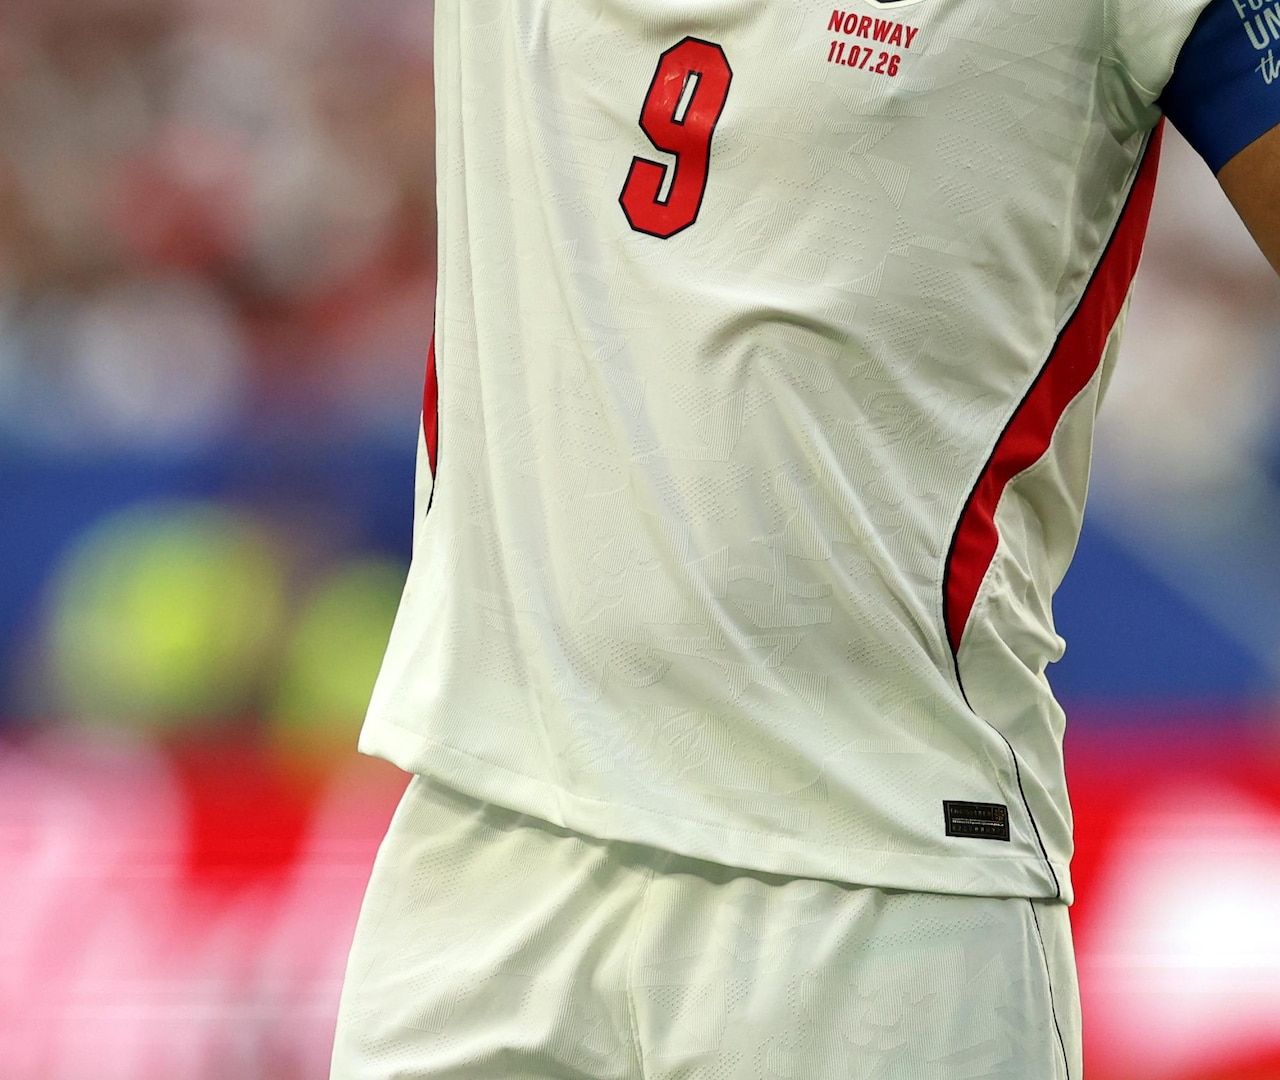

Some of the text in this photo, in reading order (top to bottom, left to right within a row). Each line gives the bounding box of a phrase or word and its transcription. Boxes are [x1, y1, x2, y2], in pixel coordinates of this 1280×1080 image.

[827, 9, 919, 49] NORWAY
[827, 40, 901, 77] 11.07.26
[618, 36, 733, 240] 9
